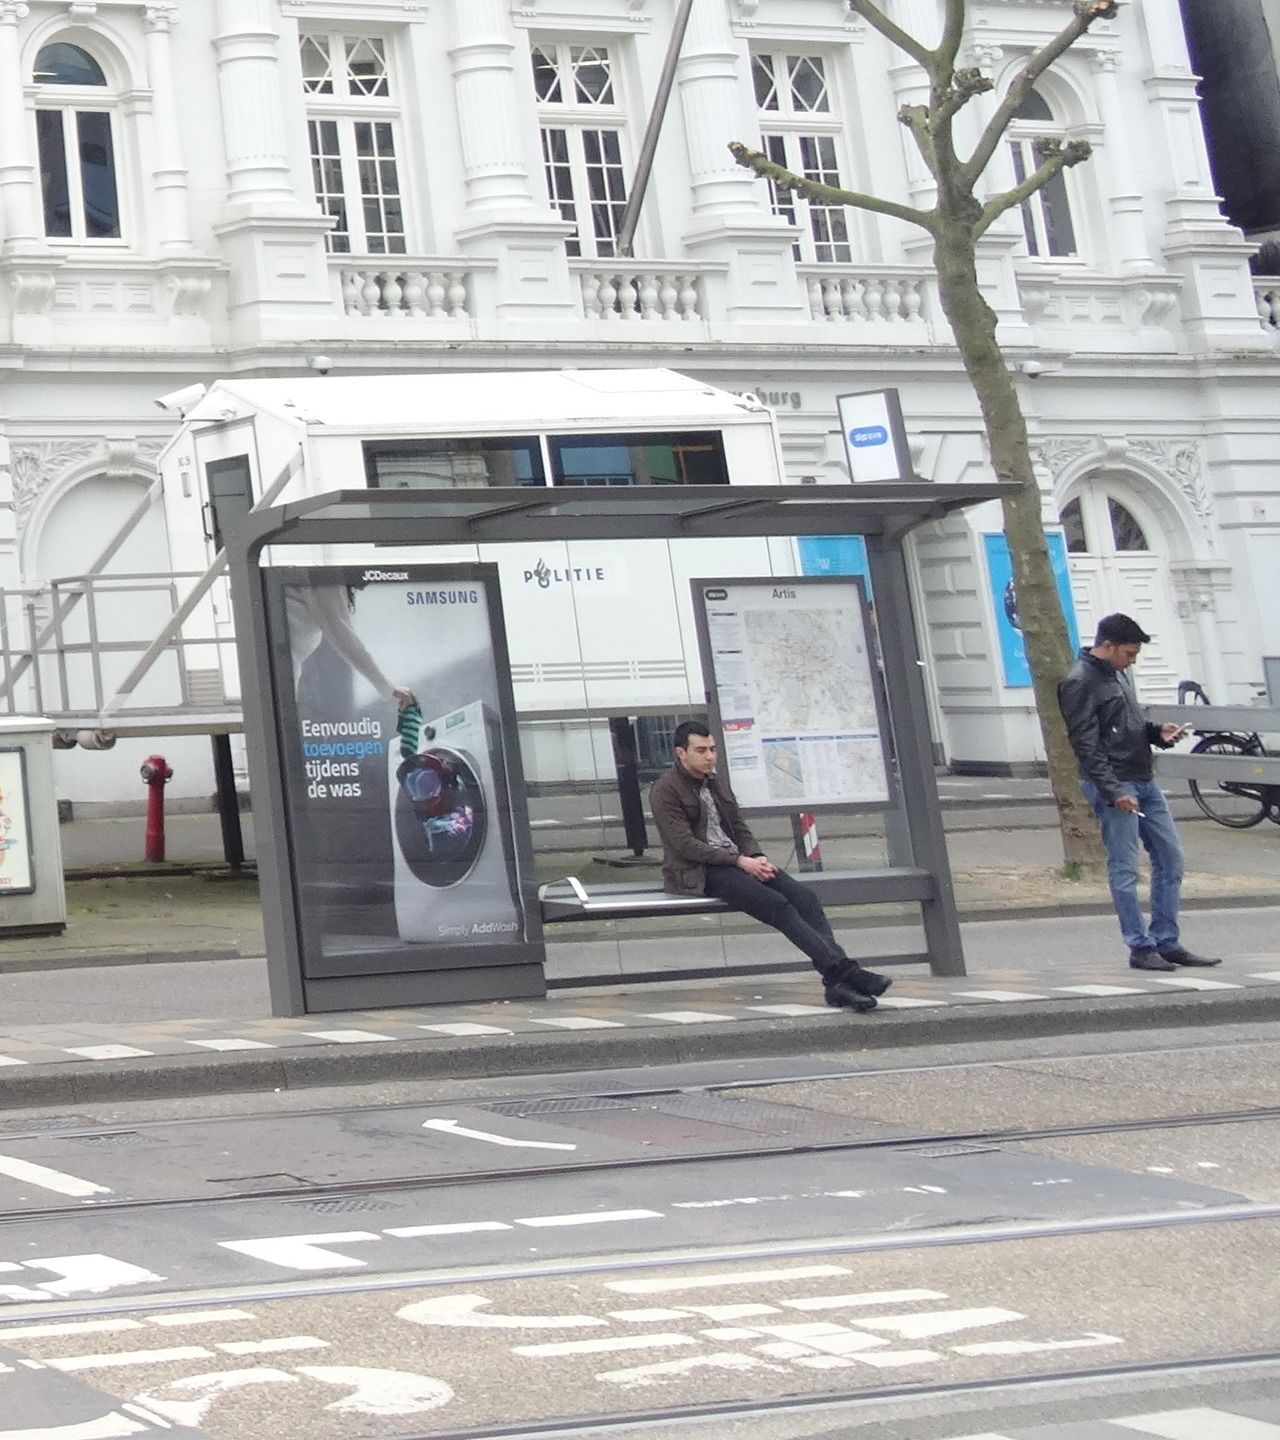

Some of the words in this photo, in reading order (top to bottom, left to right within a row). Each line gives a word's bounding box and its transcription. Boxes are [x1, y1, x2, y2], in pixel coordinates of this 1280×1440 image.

[361, 570, 409, 581] JCDecaux
[523, 566, 605, 589] POLITIE
[406, 590, 478, 606] SAMSUNG
[772, 588, 797, 599] Artis
[302, 717, 381, 739] Eenvoudig
[303, 740, 384, 760] toevoegen
[305, 759, 360, 782] tijdens
[308, 781, 327, 799] de
[329, 782, 362, 797] was
[438, 924, 470, 938] Simply
[471, 921, 518, 935] AddWash
